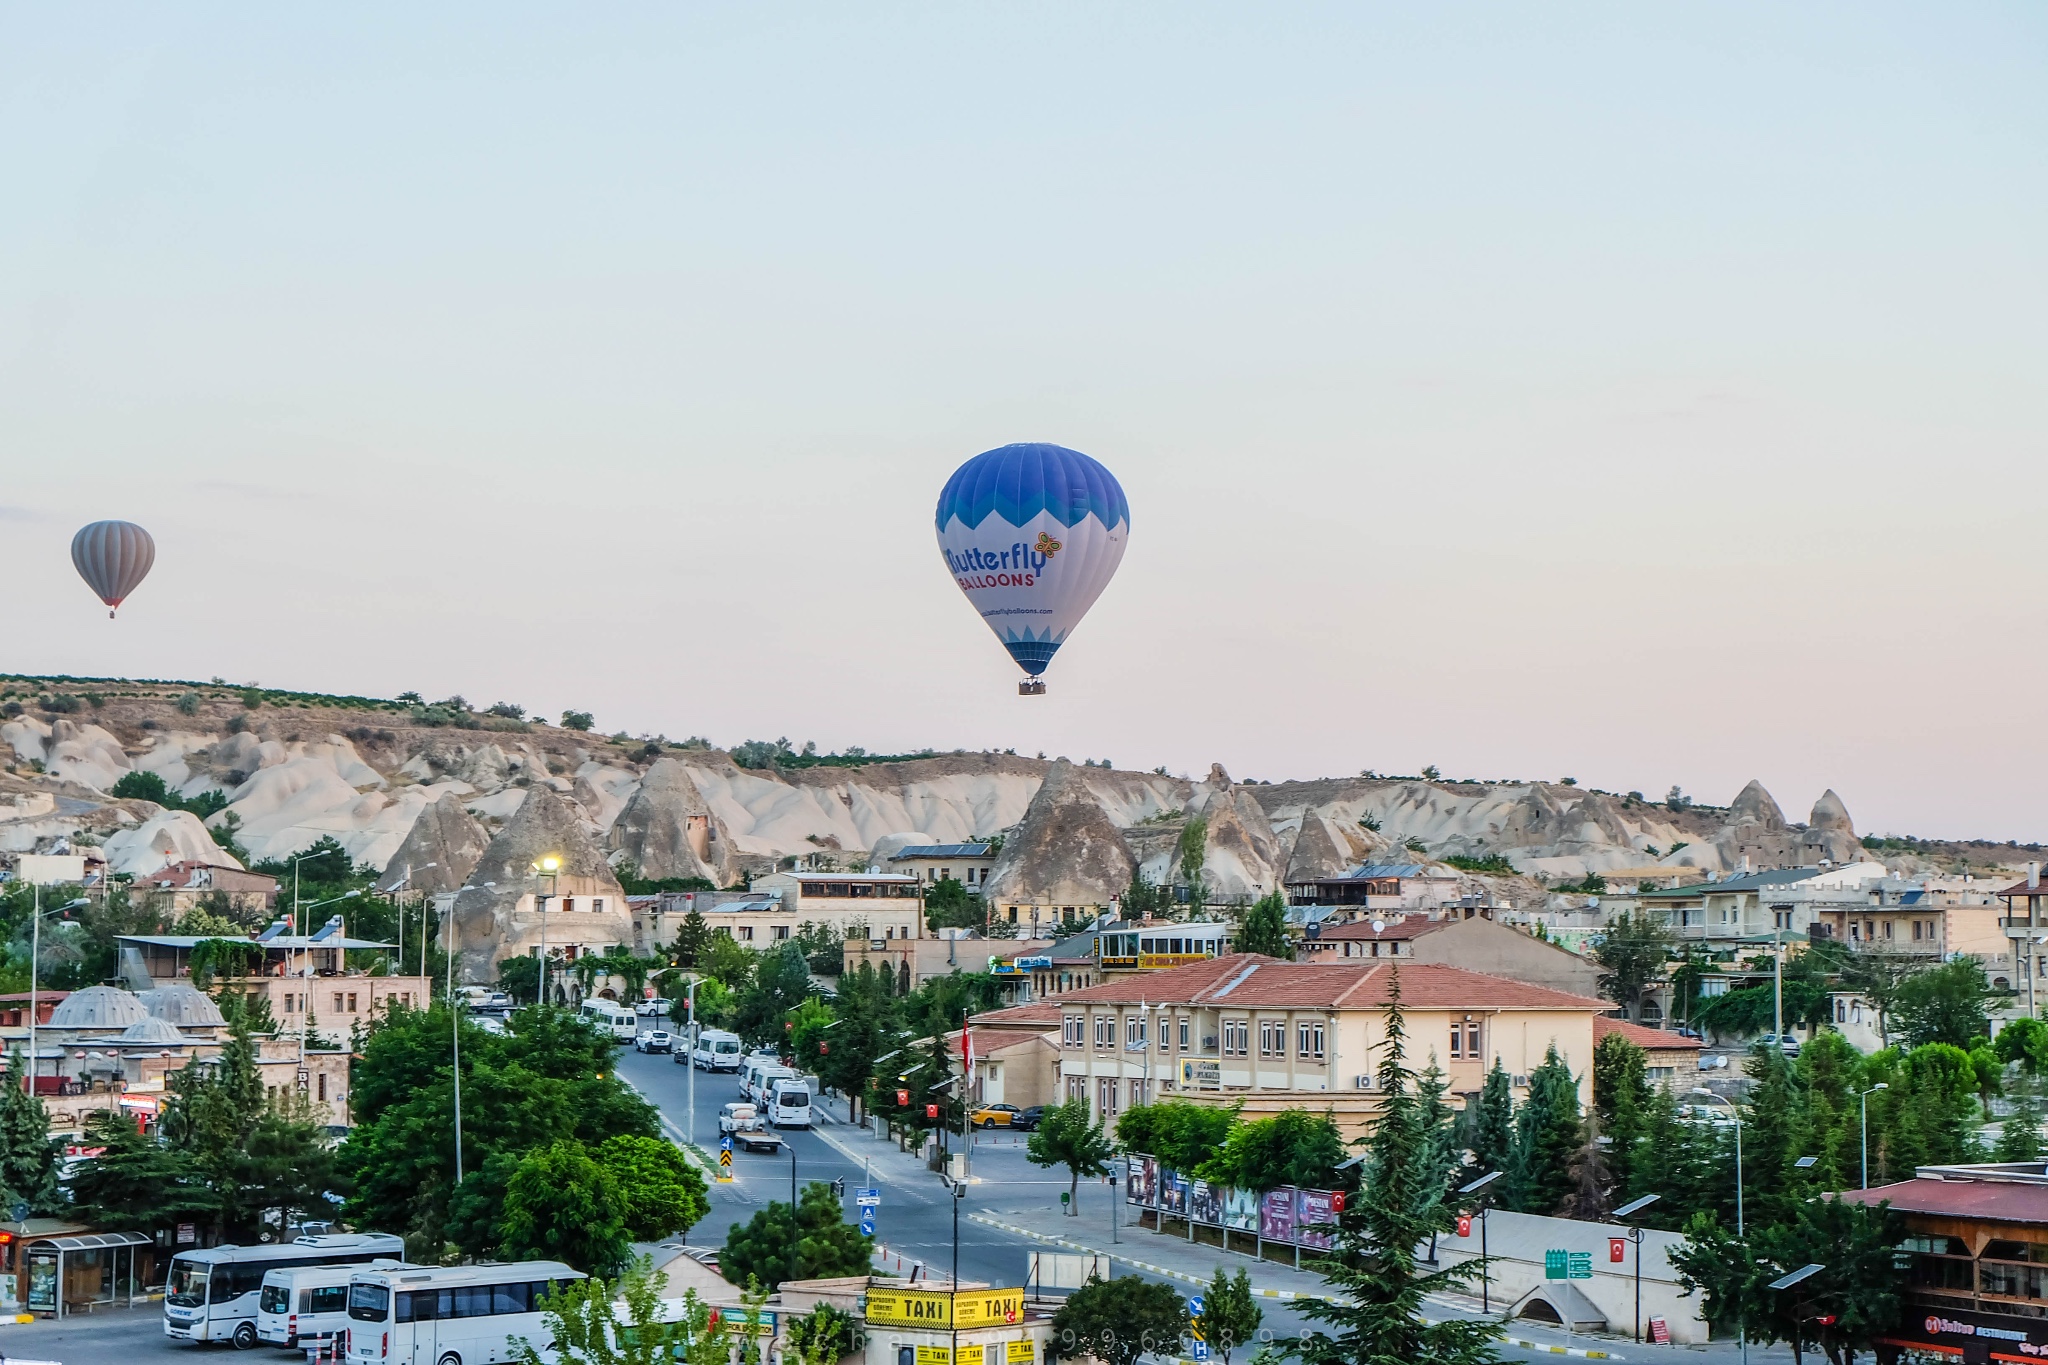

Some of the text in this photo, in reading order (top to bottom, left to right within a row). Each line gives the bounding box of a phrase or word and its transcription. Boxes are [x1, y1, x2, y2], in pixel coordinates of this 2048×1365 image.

[946, 543, 1047, 577] Butterfly
[958, 574, 1035, 590] BALLOONS
[1926, 1318, 1938, 1331] 01
[1196, 1342, 1207, 1355] H
